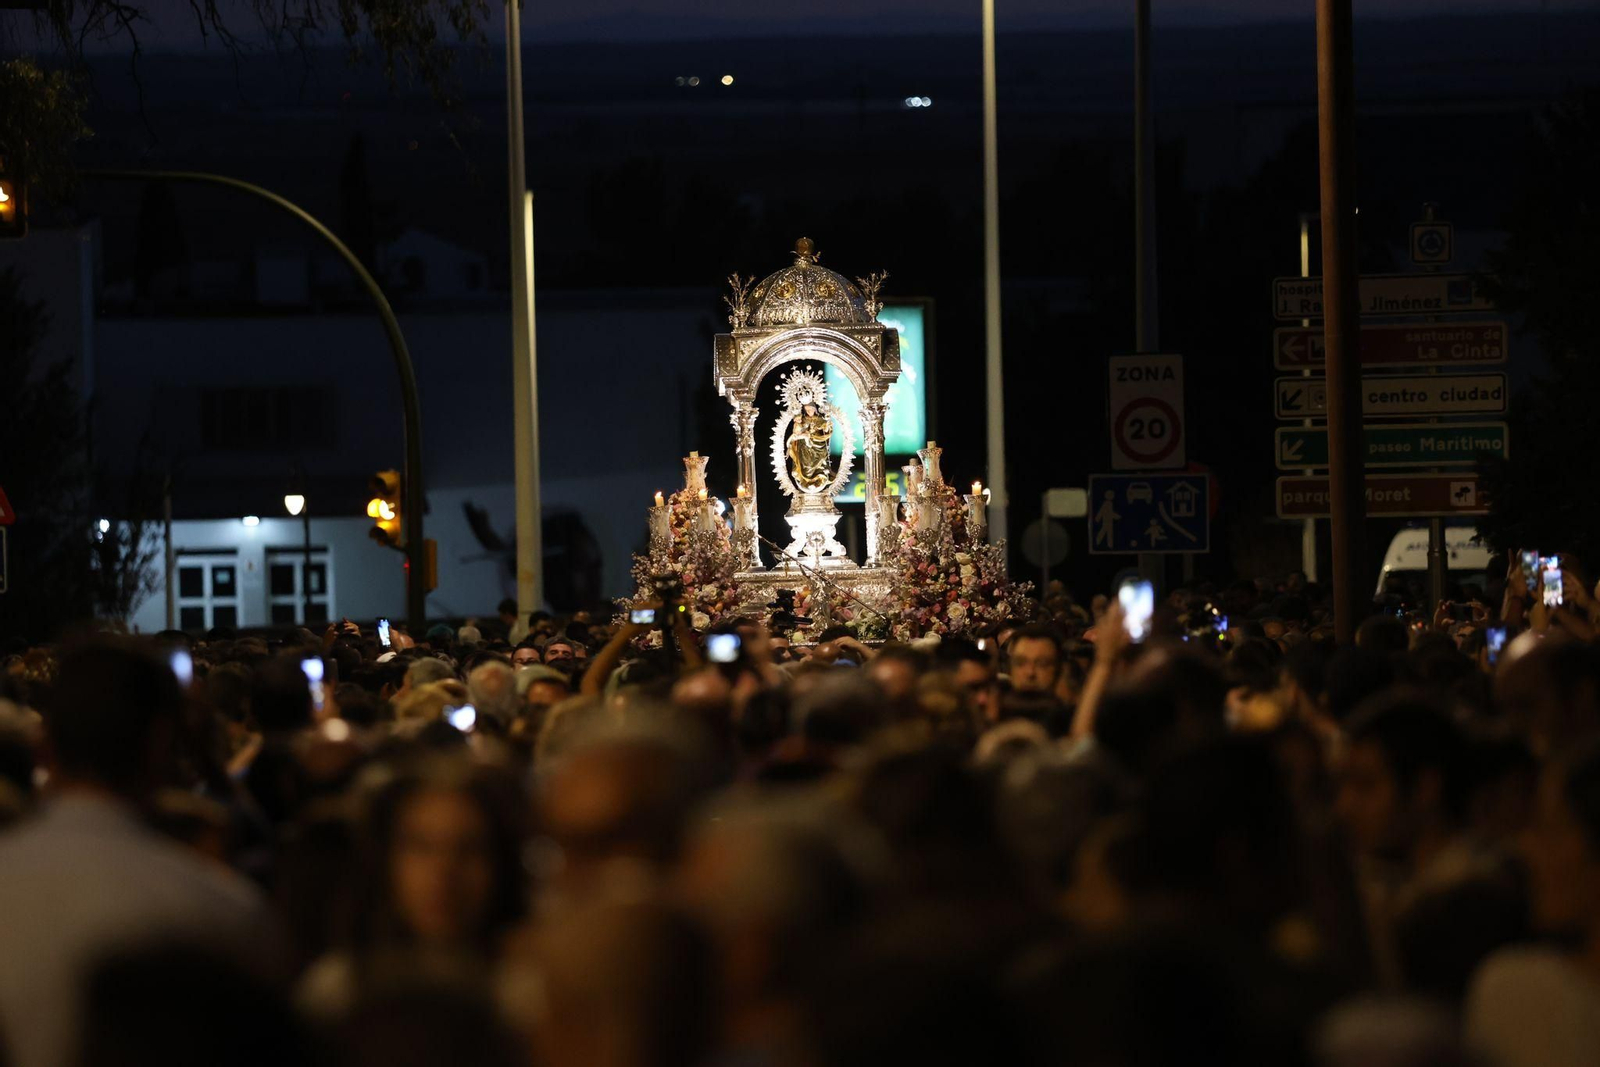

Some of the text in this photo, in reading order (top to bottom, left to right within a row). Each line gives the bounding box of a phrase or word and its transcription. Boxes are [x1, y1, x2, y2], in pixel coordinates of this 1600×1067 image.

[1369, 294, 1441, 310] Jiménez
[1405, 328, 1501, 342] santuario de
[1417, 343, 1501, 359] La Cinta
[1116, 366, 1175, 382] ZONA
[1368, 386, 1502, 403] centro ciudad
[1129, 419, 1166, 440] 20
[1369, 435, 1503, 455] paseo Marítimo
